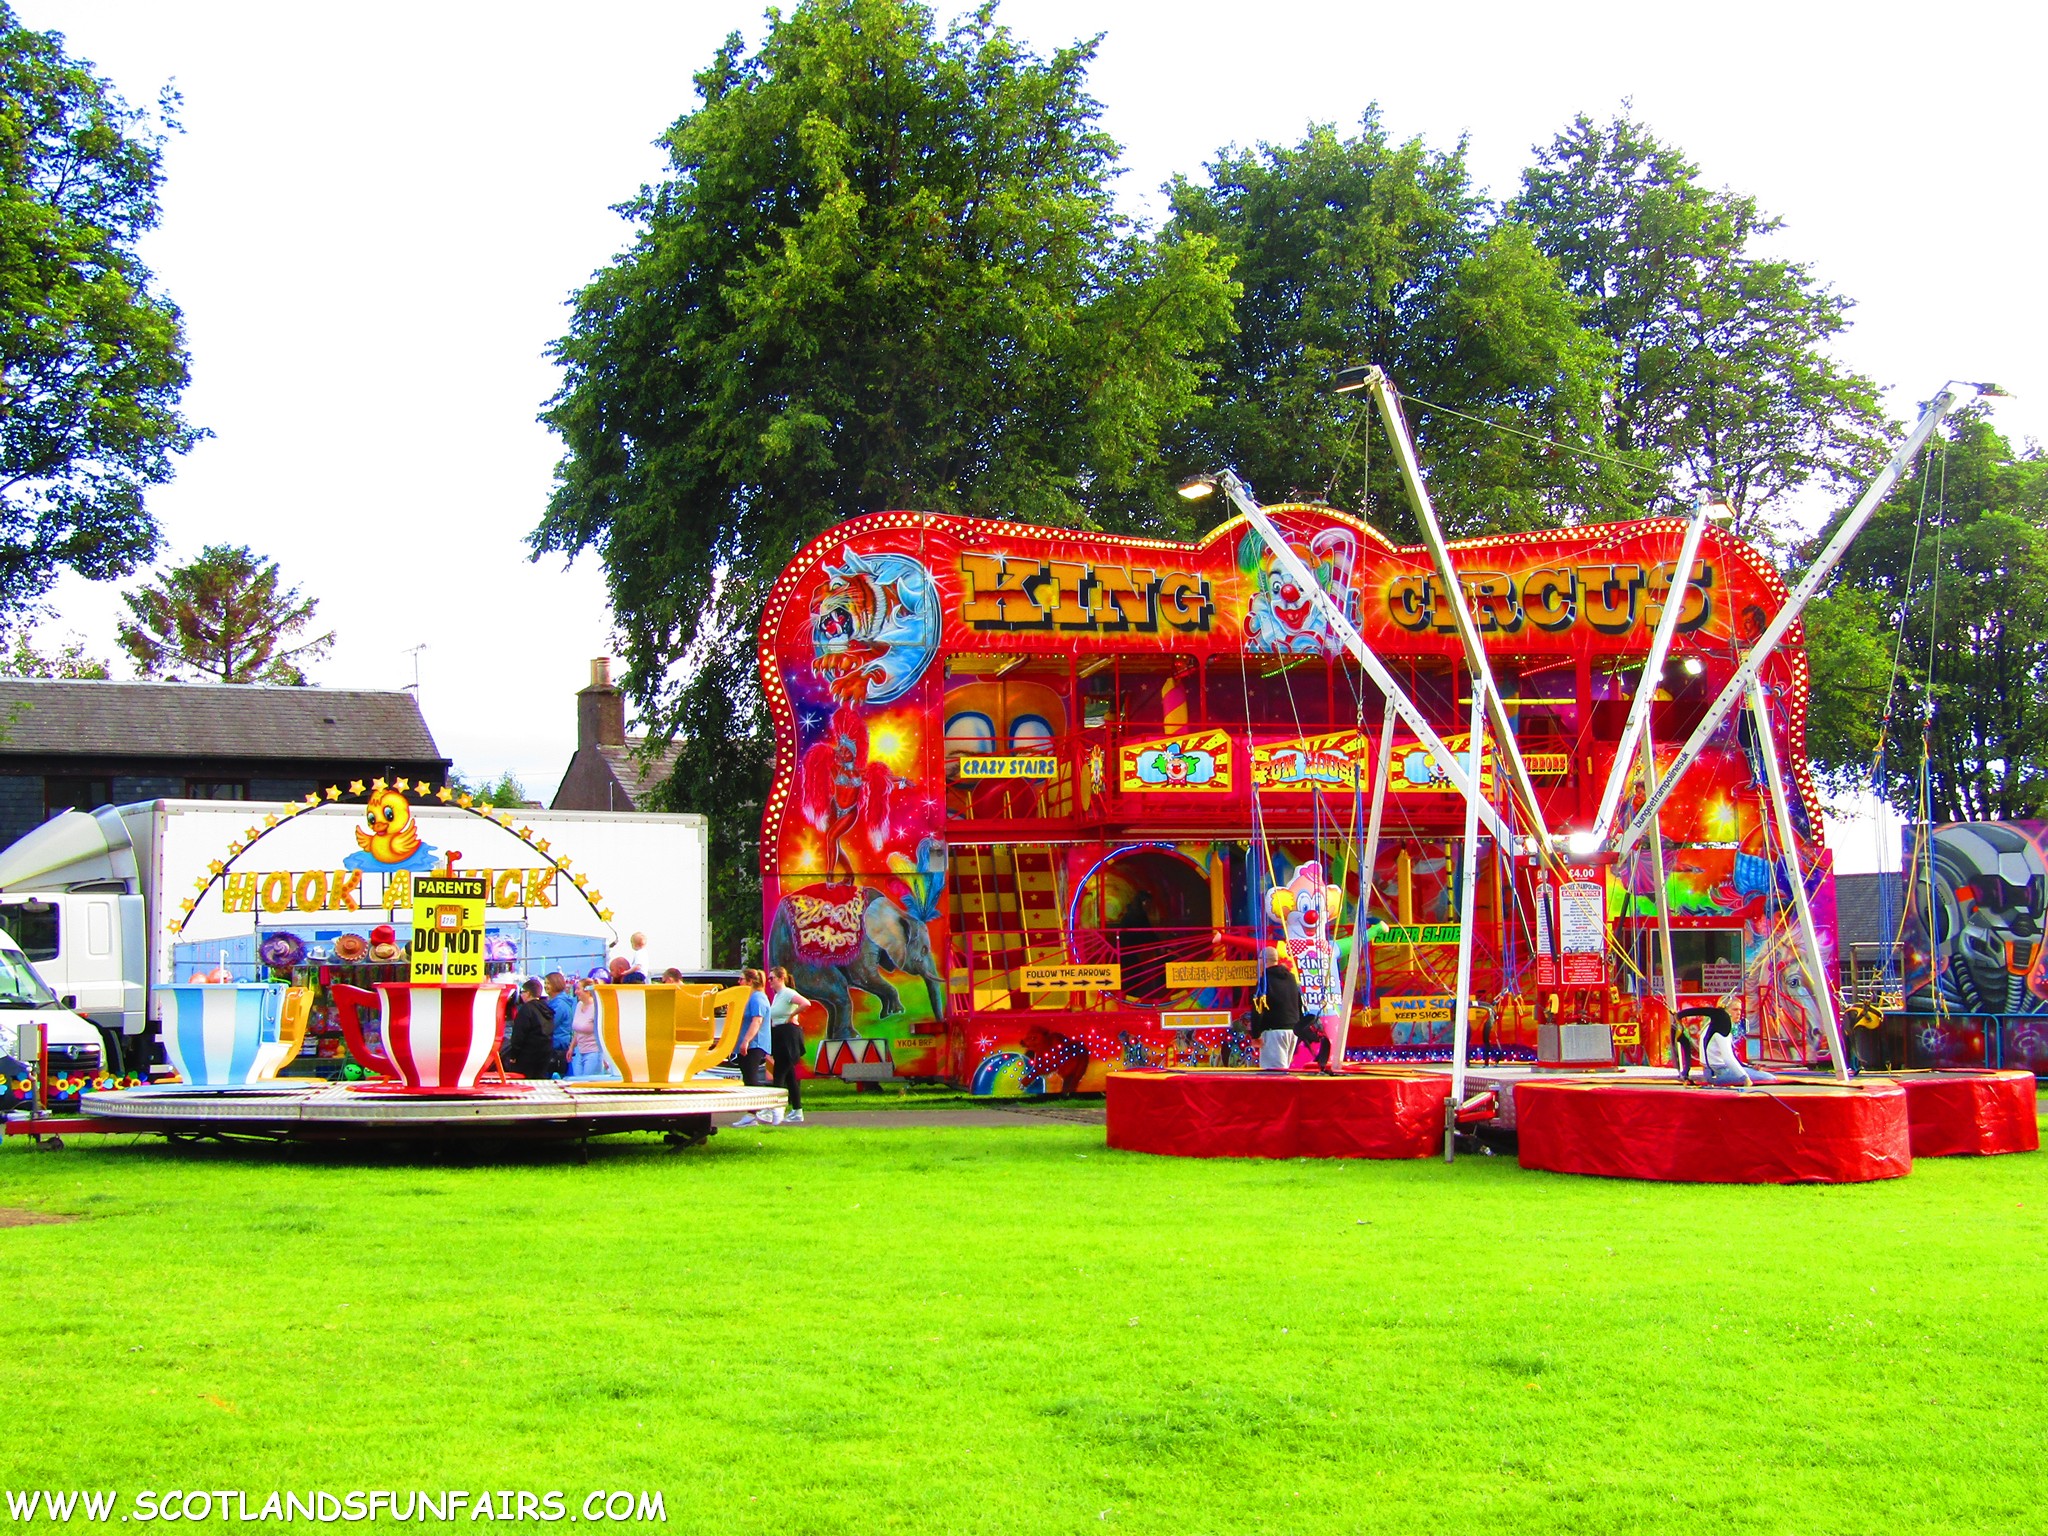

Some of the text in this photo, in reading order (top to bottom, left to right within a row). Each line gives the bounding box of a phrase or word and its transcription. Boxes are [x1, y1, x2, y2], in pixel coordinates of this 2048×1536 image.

[961, 551, 1712, 634] KING CIRCUS
[963, 760, 1055, 774] CRAZY STAIRS
[1257, 753, 1297, 783] FUN
[1524, 757, 1566, 772] IRRORS
[223, 869, 363, 913] HOOK
[382, 869, 412, 909] A
[418, 881, 482, 894] PARENTS
[414, 928, 482, 953] DO NOT
[415, 963, 478, 975] SPIN CUPS
[1026, 970, 1057, 978] FOLLOW
[1078, 968, 1111, 976] ARROWS
[1391, 999, 1456, 1010] WALK SLO
[1395, 1011, 1449, 1020] KEEP SHOES
